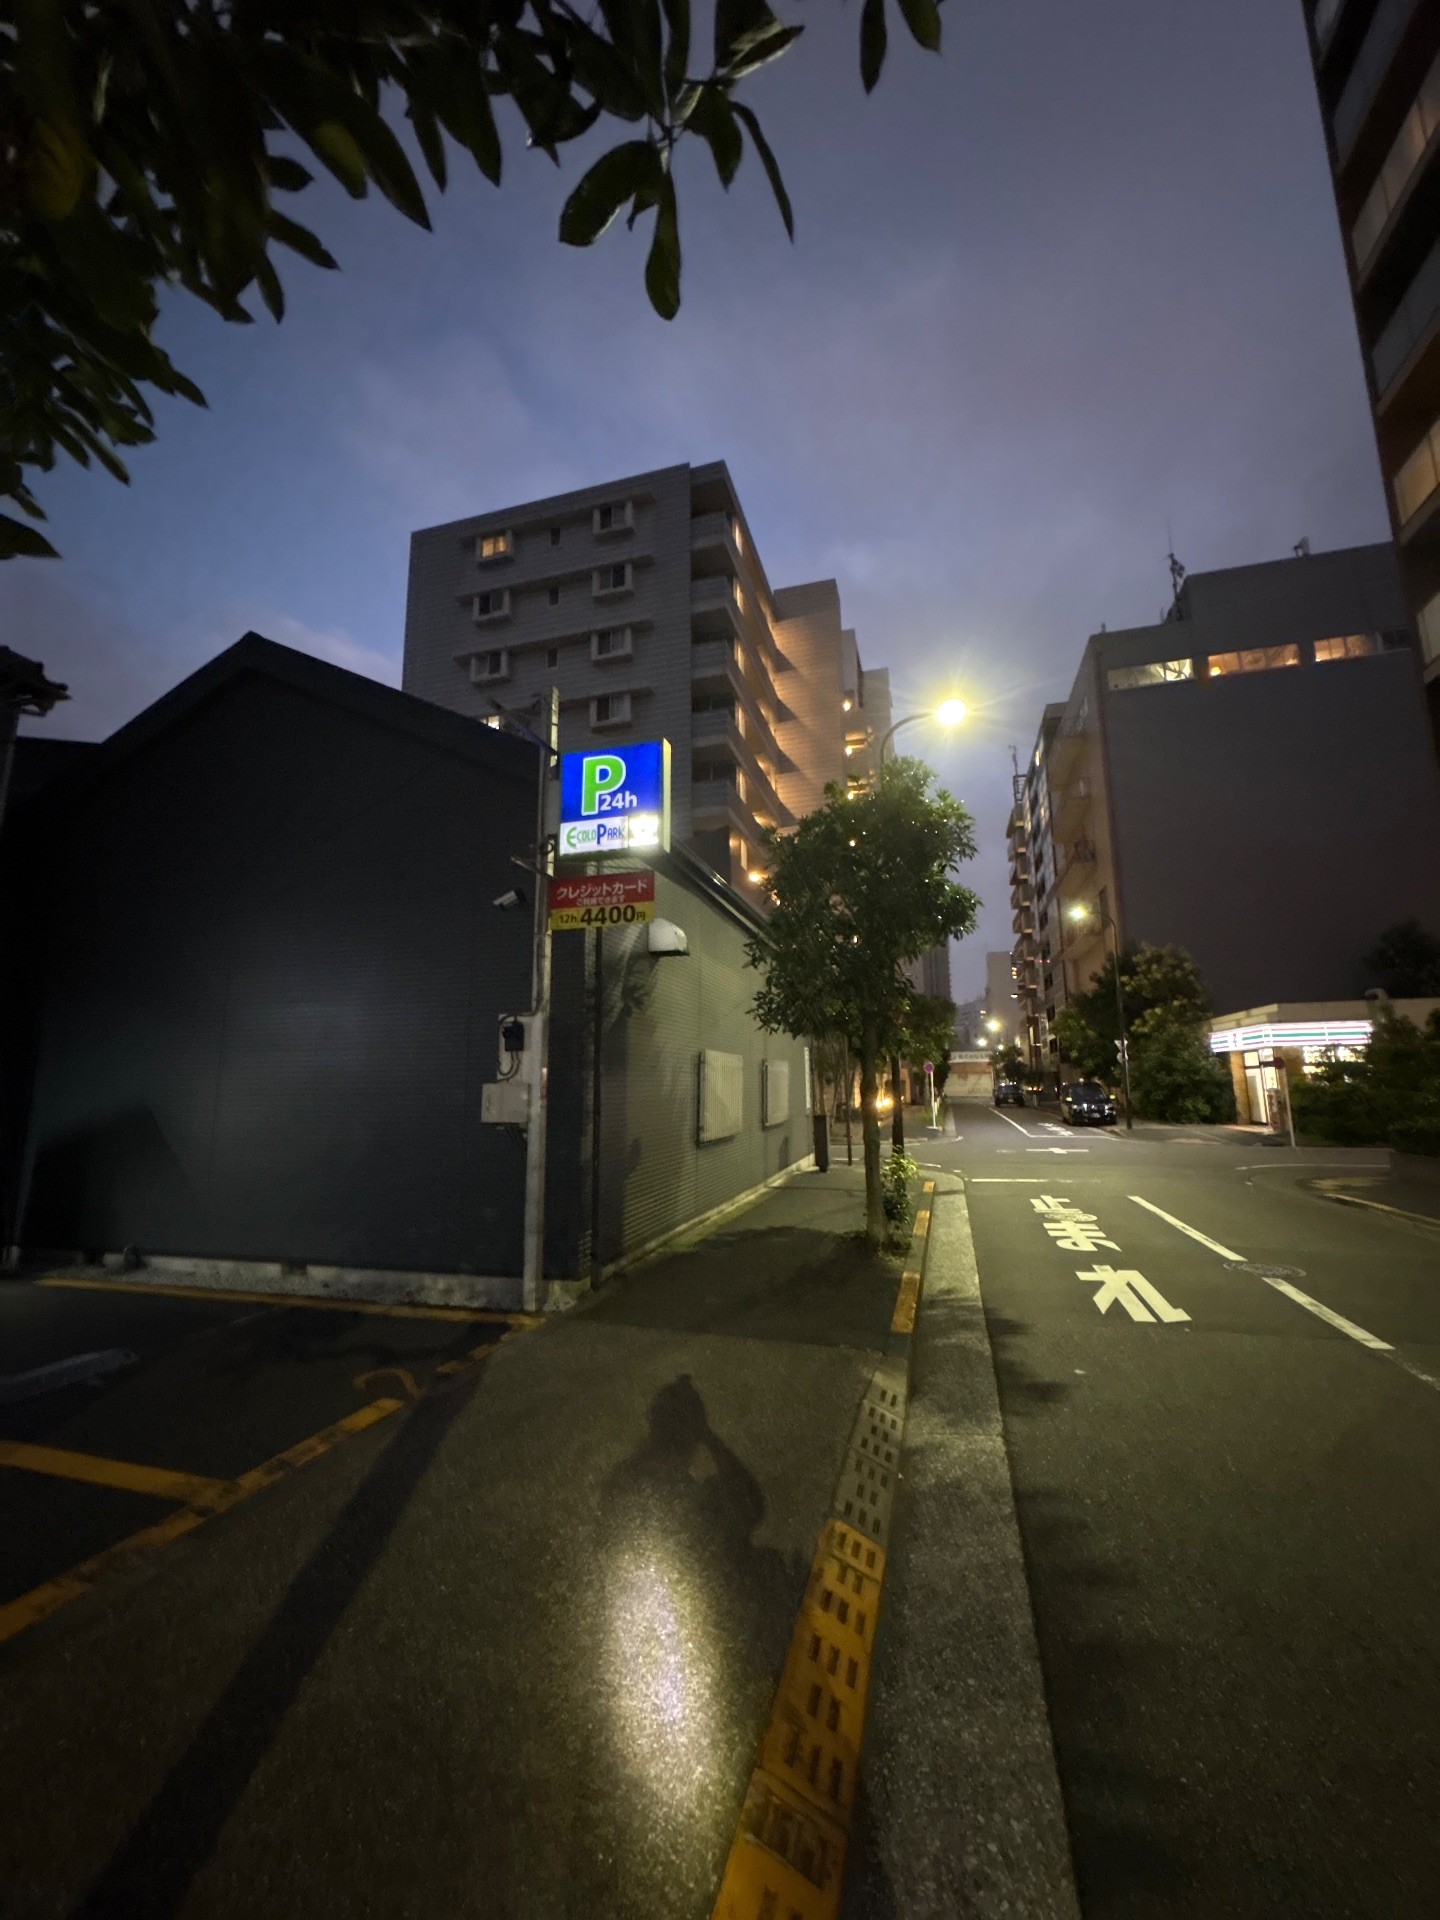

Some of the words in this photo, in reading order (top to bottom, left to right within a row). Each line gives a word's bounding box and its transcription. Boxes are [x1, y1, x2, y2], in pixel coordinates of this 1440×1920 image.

[581, 755, 627, 817] P
[599, 792, 638, 811] 24h
[556, 879, 648, 900] クレジットカード
[559, 913, 577, 924] 12h
